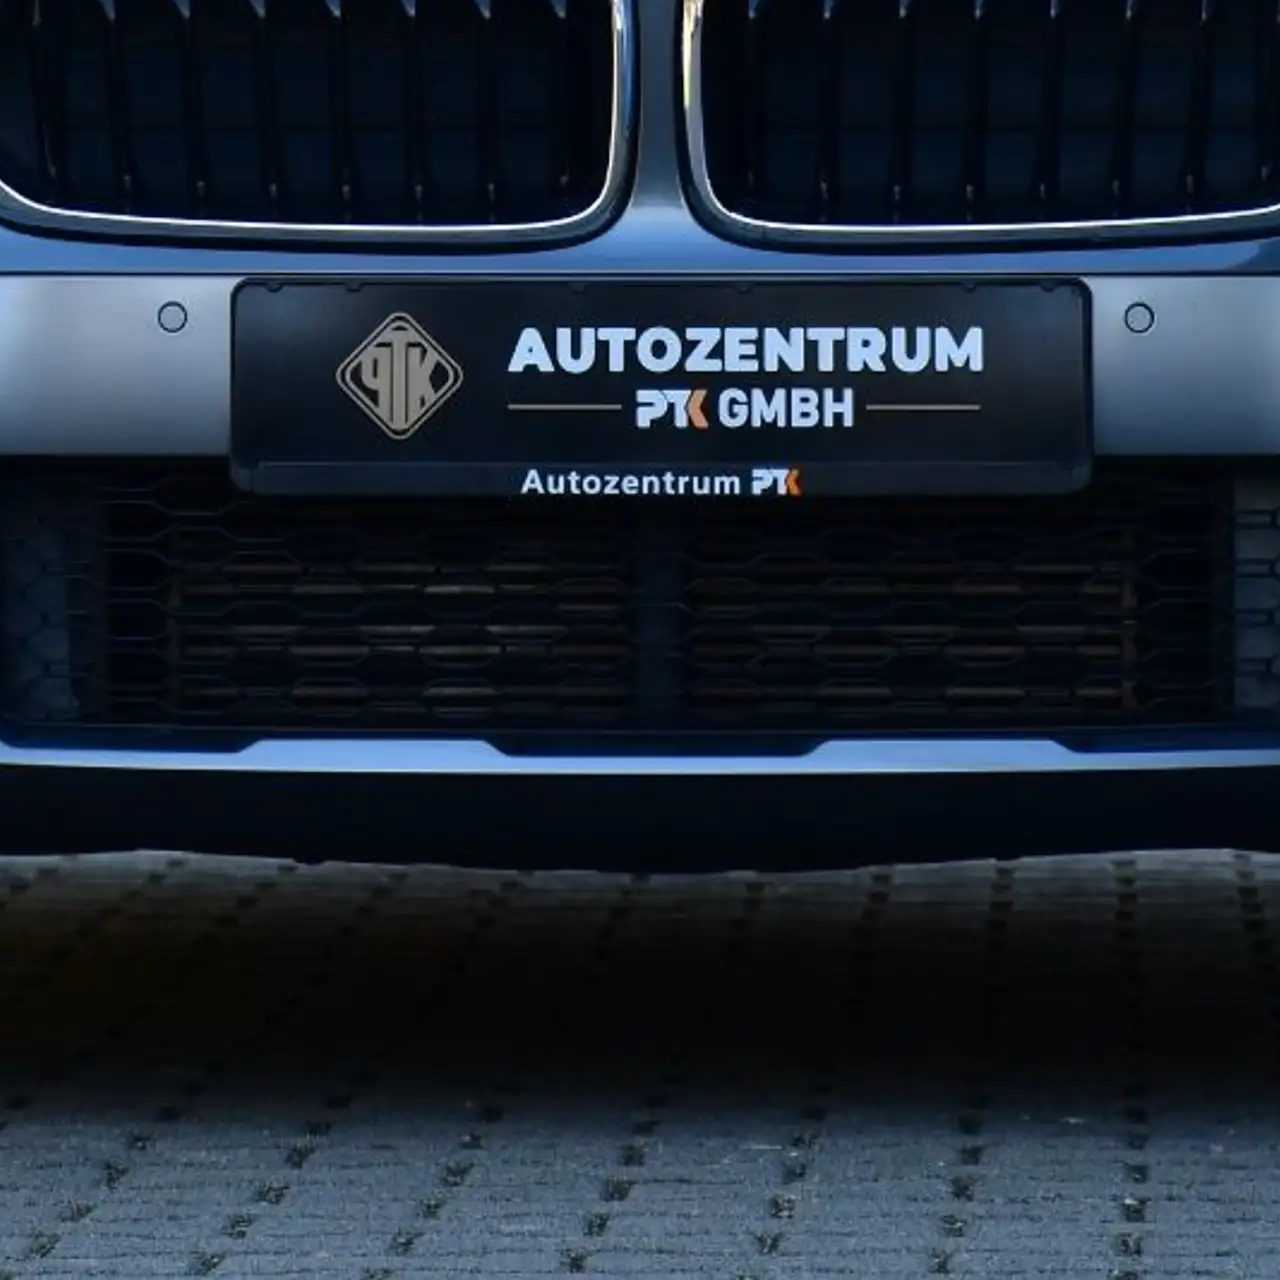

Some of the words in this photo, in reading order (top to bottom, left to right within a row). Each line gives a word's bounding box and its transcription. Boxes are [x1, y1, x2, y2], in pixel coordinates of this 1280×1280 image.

[507, 325, 984, 374] AUTOZENTRUM
[717, 387, 854, 428] GMBH
[520, 468, 741, 495] Autozentrum
